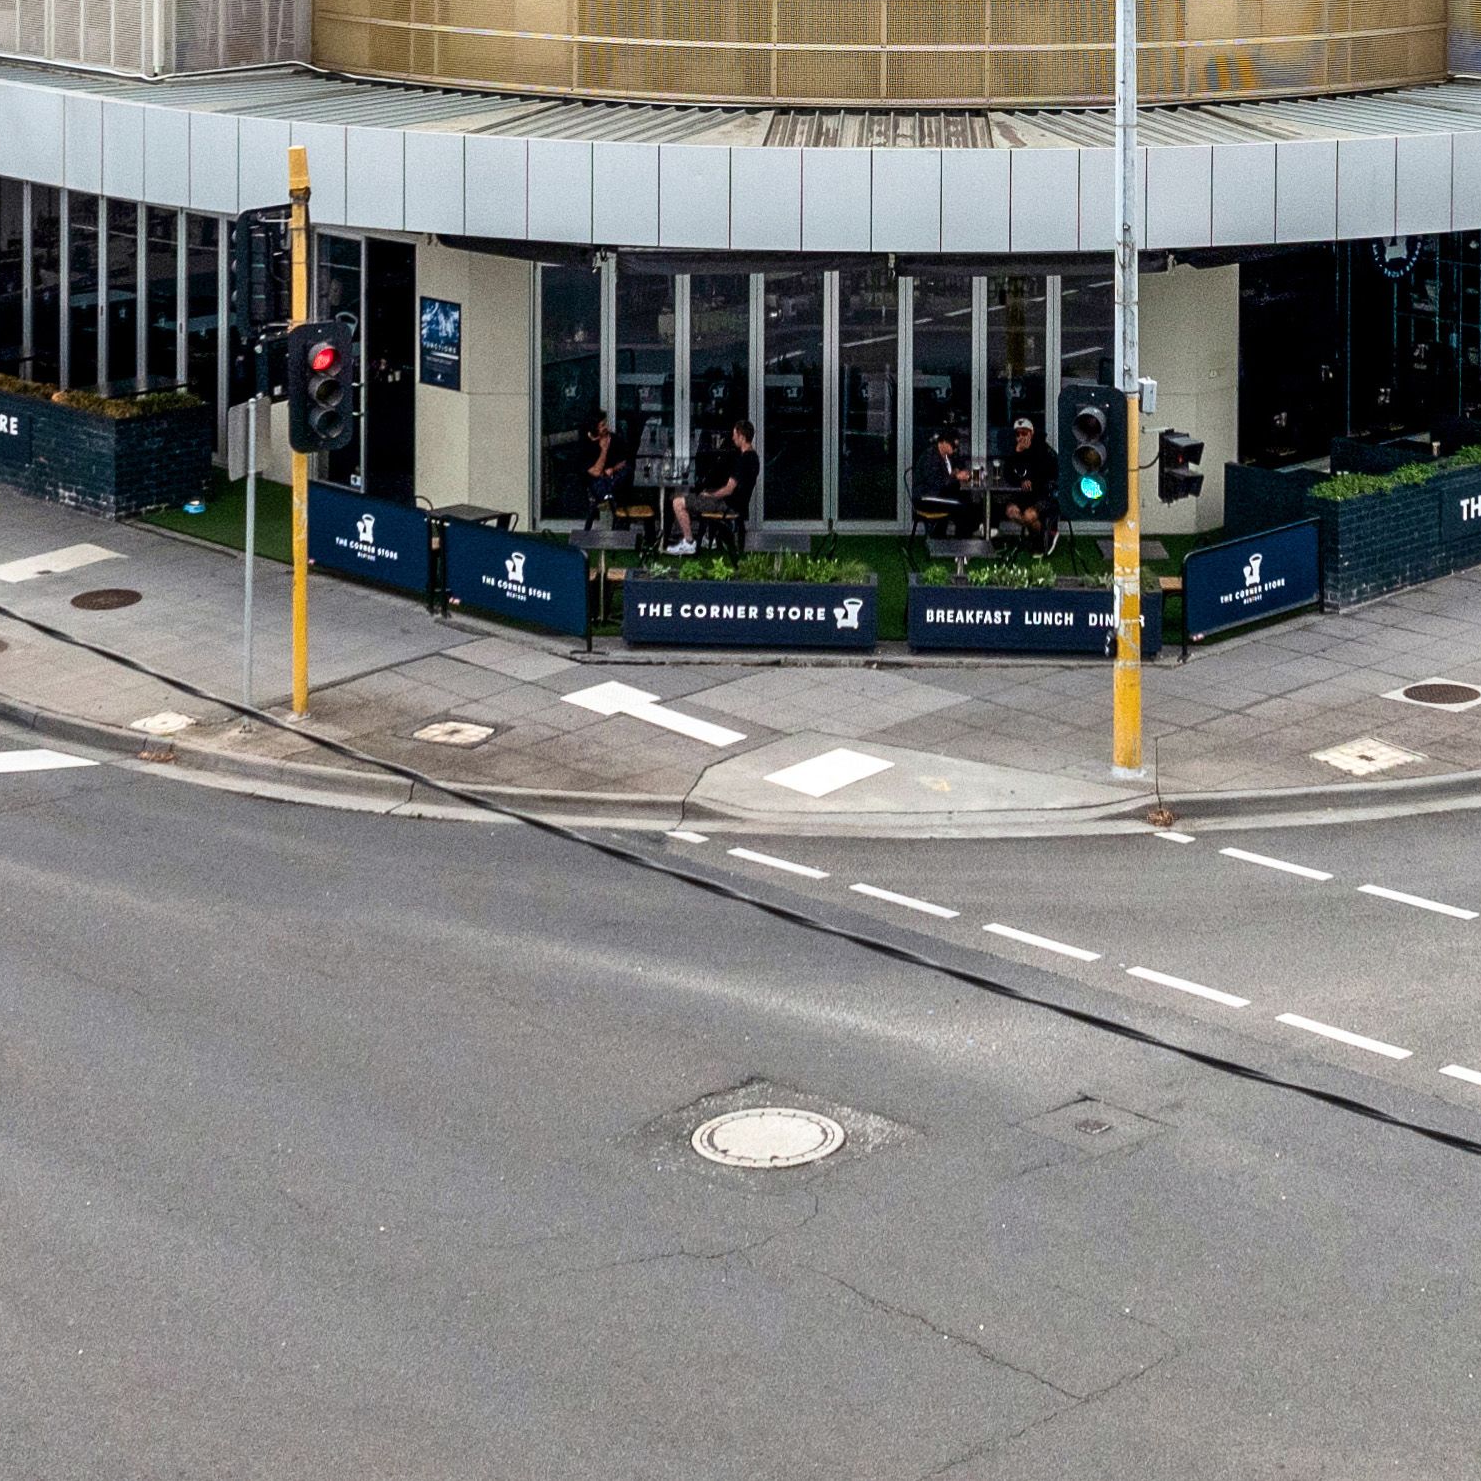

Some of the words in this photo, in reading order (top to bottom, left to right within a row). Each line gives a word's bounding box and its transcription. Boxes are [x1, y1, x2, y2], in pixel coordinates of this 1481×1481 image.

[335, 536, 348, 548] THE
[349, 540, 376, 554] CORNER
[377, 547, 398, 560] STORE
[481, 575, 495, 587] THE
[497, 579, 526, 594] CORNER
[528, 587, 551, 601] STORE
[1220, 593, 1233, 604] THE
[1235, 585, 1262, 600] CORNER
[1264, 577, 1286, 591] STORE
[637, 603, 673, 618] THE
[679, 604, 759, 619] CORNER
[765, 606, 826, 621] STORE
[926, 609, 1011, 625] BREAKFAST
[1024, 611, 1074, 626] LUNCH
[1088, 613, 1145, 628] DINR
